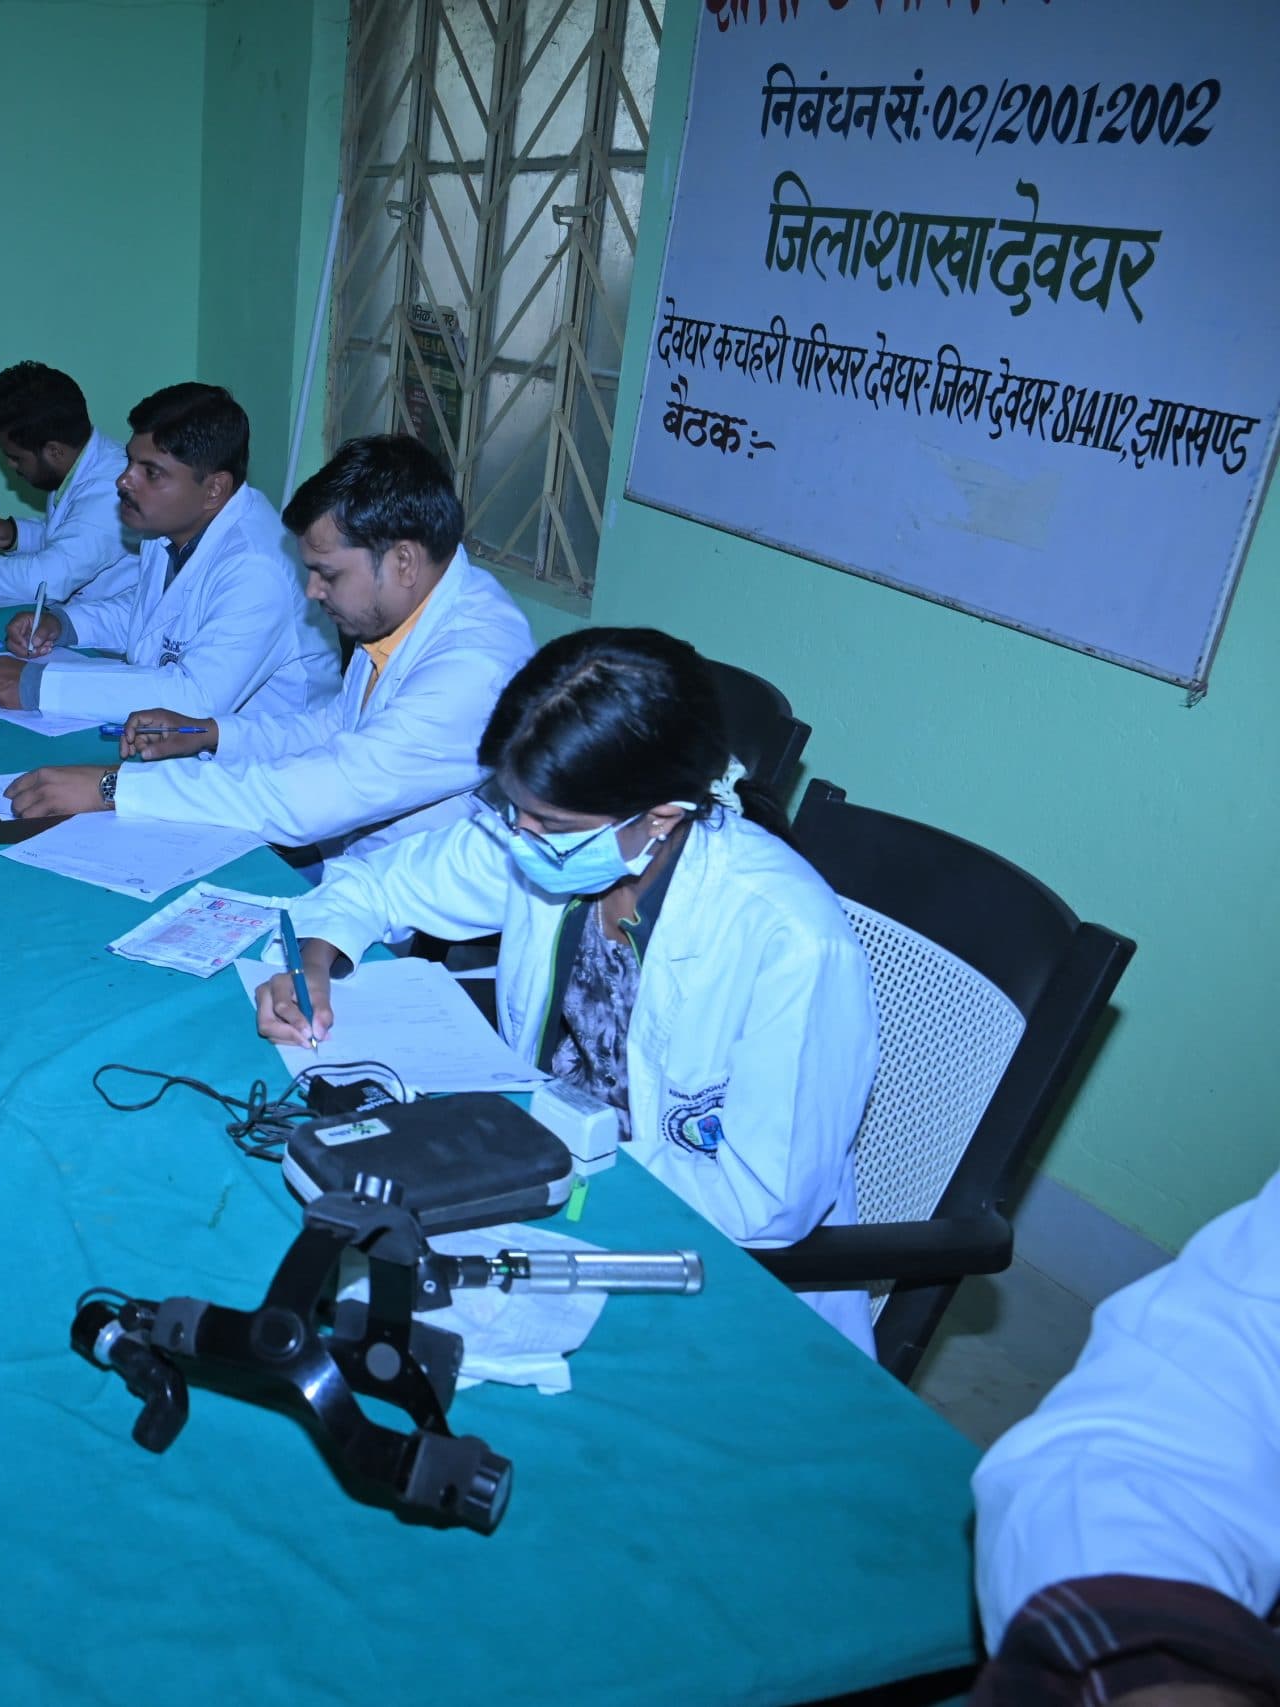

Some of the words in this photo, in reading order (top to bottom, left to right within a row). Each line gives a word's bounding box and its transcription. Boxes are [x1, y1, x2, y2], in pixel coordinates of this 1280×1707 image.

[761, 63, 885, 140] निबंधन
[765, 171, 872, 281] जिला
[658, 296, 716, 368] देवघर
[713, 315, 791, 383] कचहरी
[792, 323, 868, 399] परिसर
[1131, 398, 1261, 474] झारखण्ड
